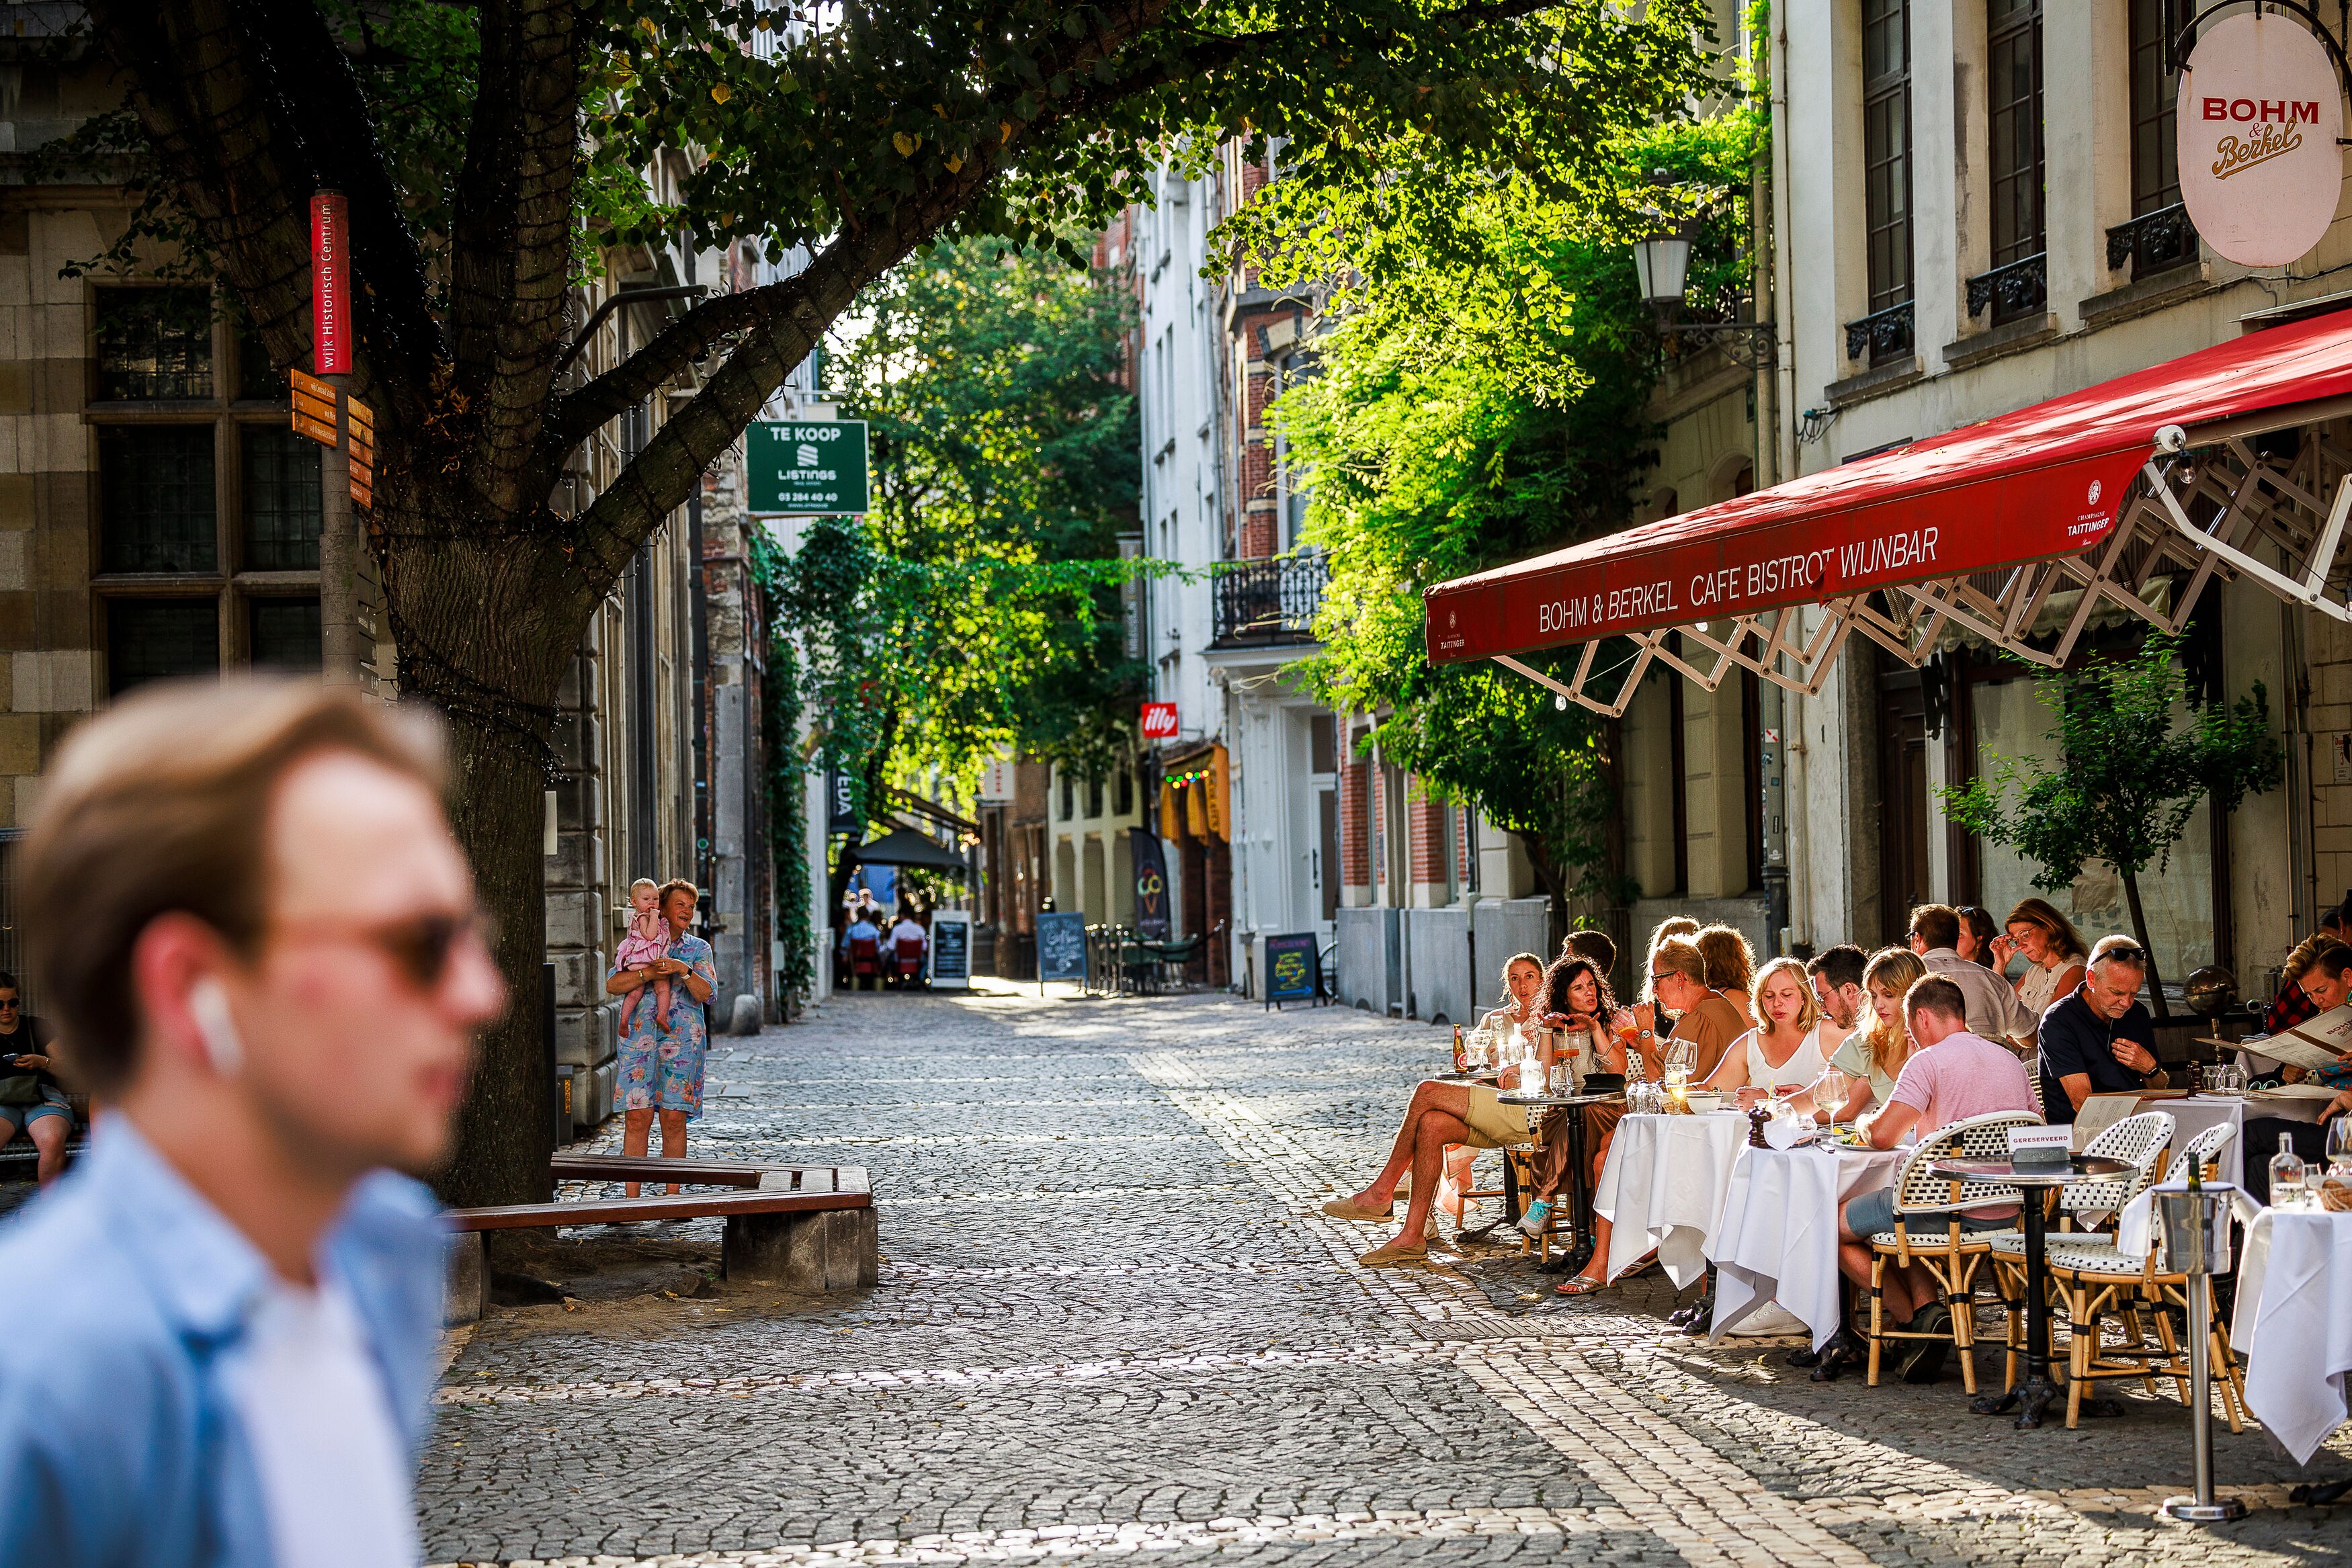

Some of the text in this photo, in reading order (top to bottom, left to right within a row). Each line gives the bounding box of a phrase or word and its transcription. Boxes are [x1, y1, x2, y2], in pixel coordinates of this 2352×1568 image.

[2201, 97, 2320, 124] BOHM
[2249, 122, 2263, 138] &
[2212, 116, 2302, 177] Berkel
[320, 204, 336, 367] wijk Historisch Centrum
[770, 427, 841, 442] TE KOOP
[778, 470, 837, 480] LISTINGS
[810, 492, 824, 502] 40
[825, 492, 839, 502] 40
[2077, 511, 2105, 521] CHAMPAGNE
[2067, 517, 2109, 536] TAITTINGER
[1539, 527, 1939, 633] BOHM & BERKEL CAFE BISTROT WIJNBAR
[1440, 639, 1465, 650] TAITTINGER
[1144, 707, 1176, 736] illy
[2013, 1135, 2068, 1143] GERESERVEERD
